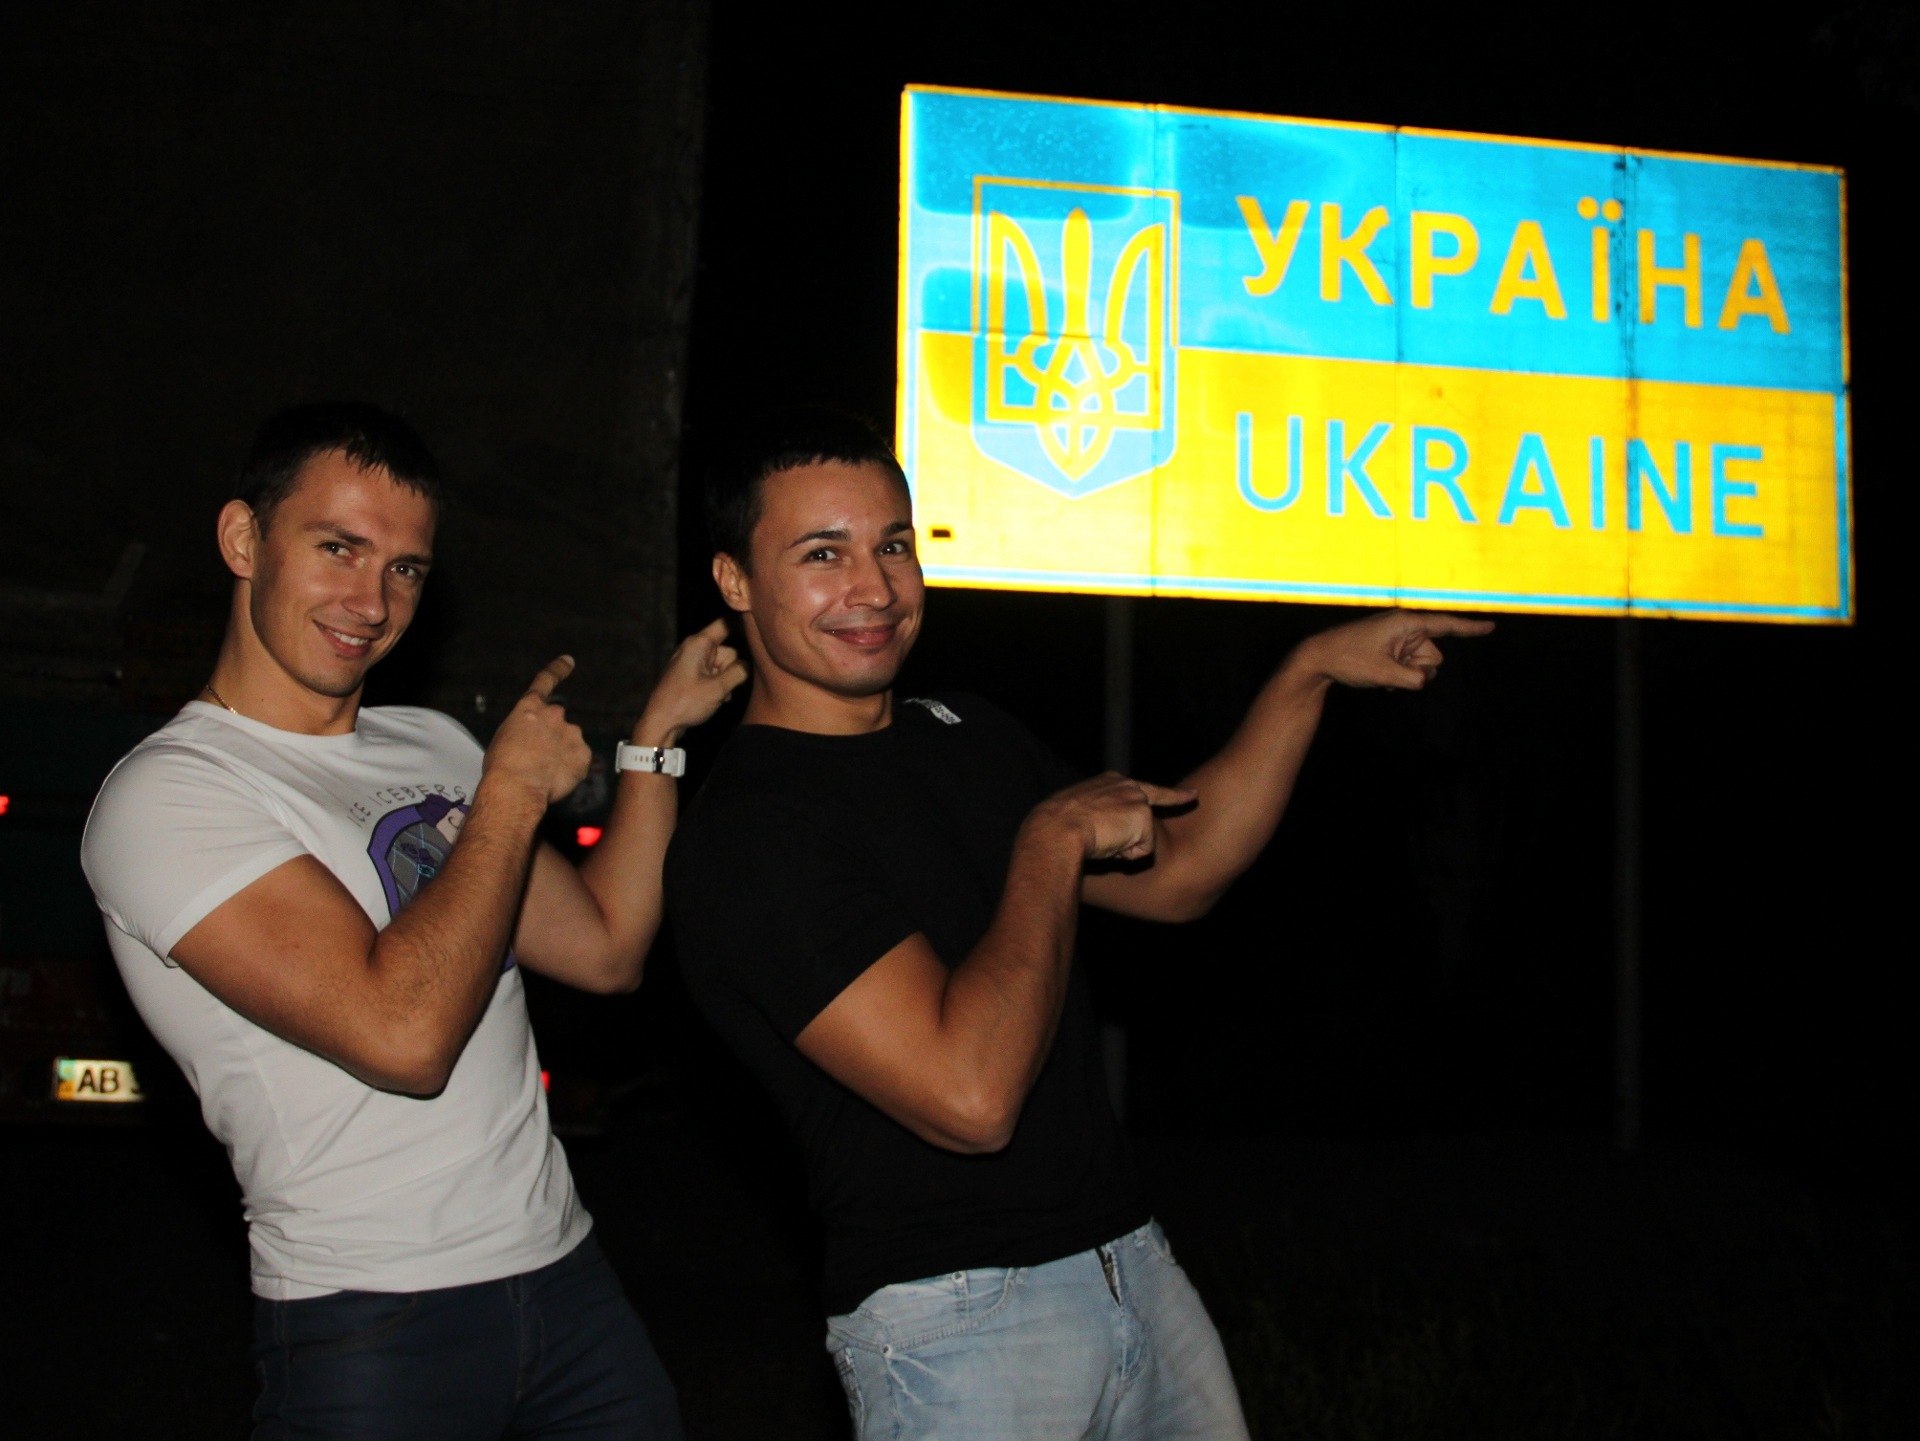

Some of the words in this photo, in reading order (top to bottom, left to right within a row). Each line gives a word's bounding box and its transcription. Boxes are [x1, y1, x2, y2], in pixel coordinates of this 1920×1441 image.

[1236, 196, 1790, 334] УКРАЇНА
[1236, 412, 1765, 538] UKRAINE
[347, 802, 371, 829] ICE
[77, 1068, 119, 1094] AB
